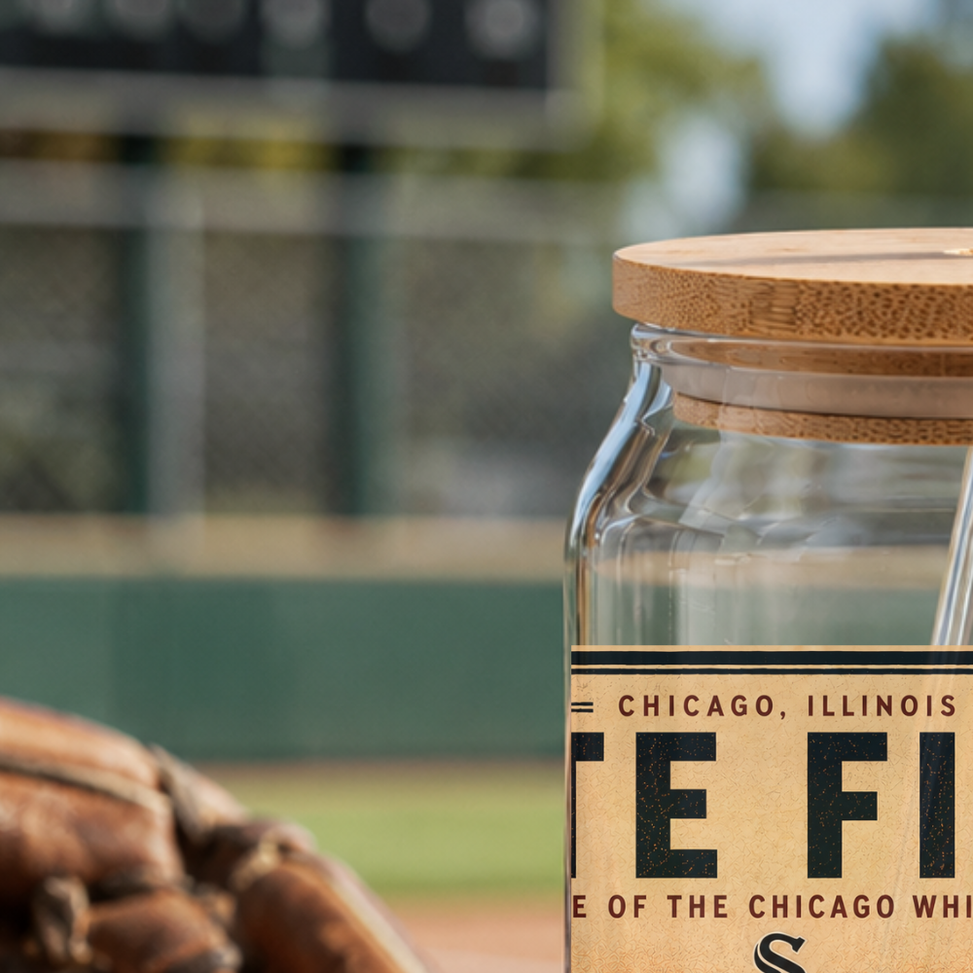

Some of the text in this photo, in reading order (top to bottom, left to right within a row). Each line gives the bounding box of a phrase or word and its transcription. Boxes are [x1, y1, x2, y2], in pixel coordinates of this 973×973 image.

[618, 694, 957, 721] CHICAGO, ILLINOIS
[573, 894, 587, 919] E
[607, 894, 648, 919] OF
[667, 894, 729, 919] THE
[748, 894, 896, 919] CHICAGO
